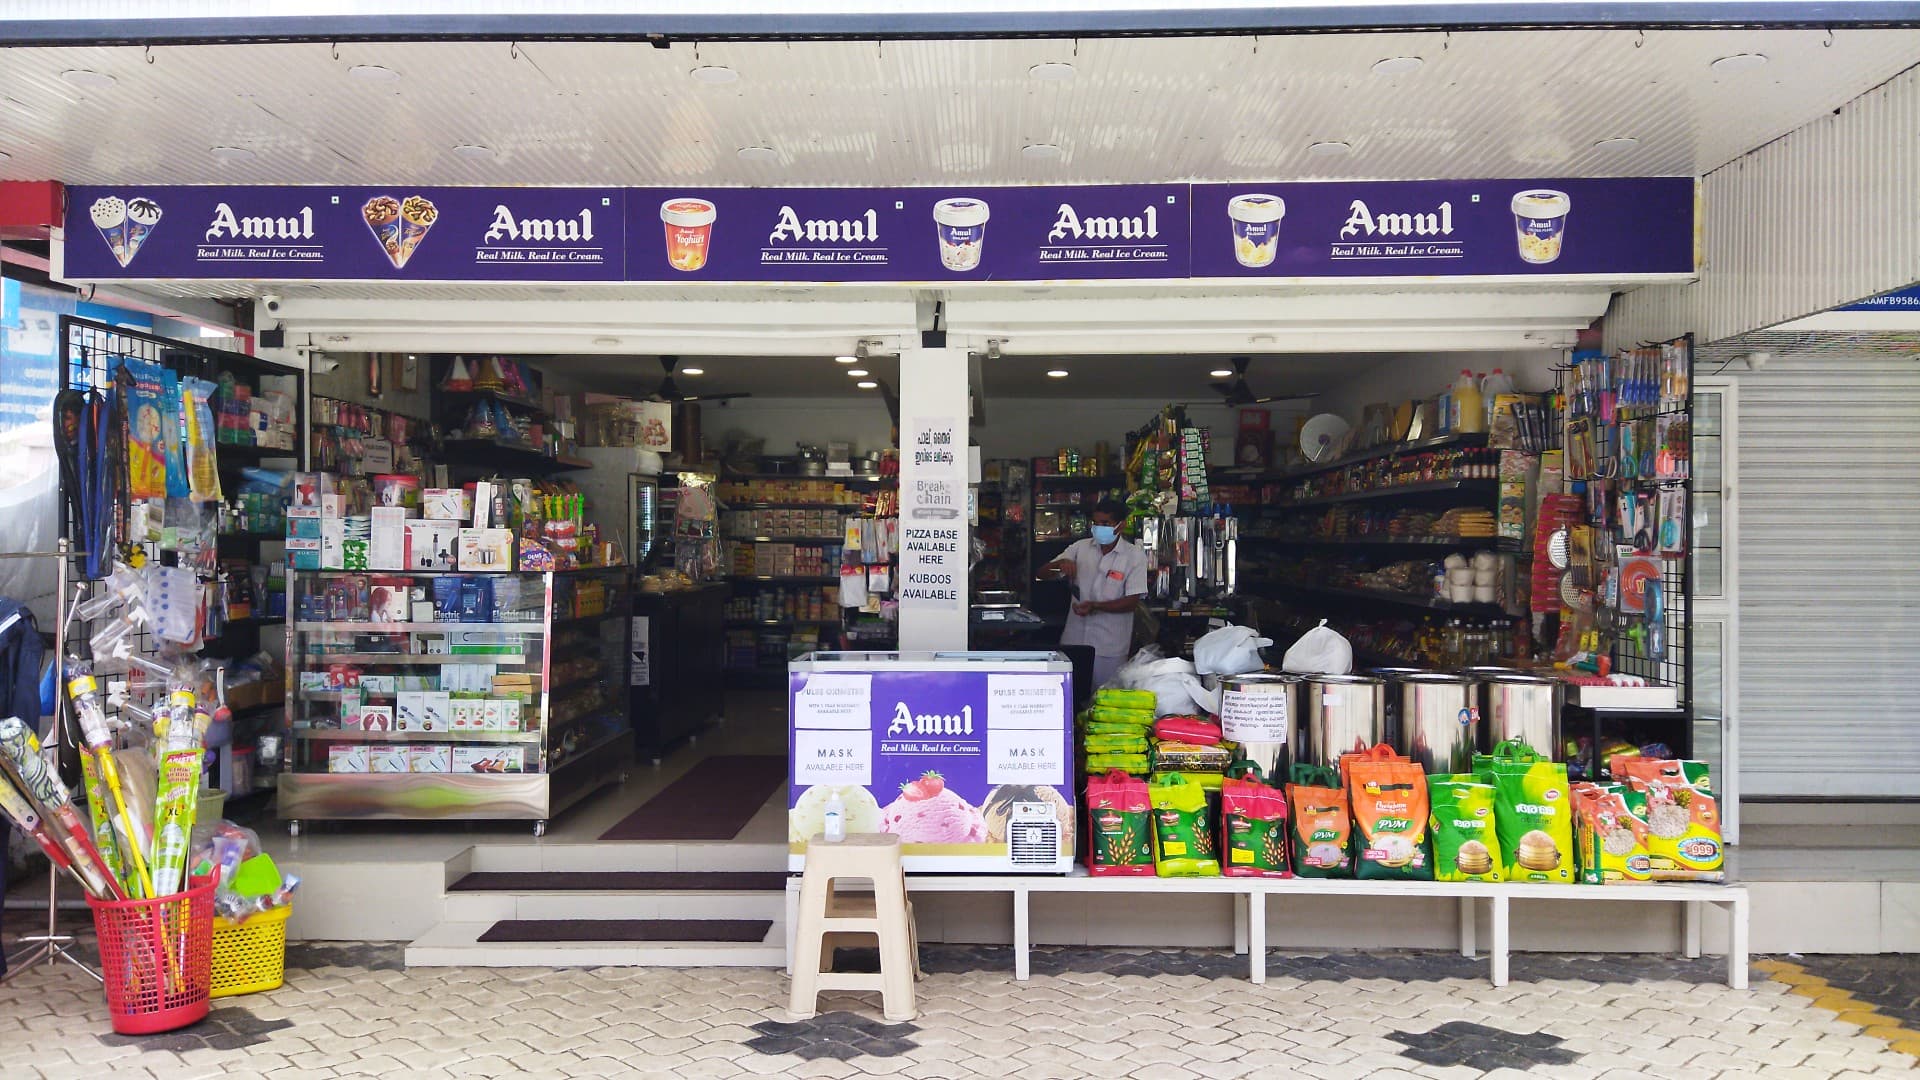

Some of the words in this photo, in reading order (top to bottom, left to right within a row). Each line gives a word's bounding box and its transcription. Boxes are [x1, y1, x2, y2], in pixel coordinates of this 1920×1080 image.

[205, 202, 315, 243] Amul
[484, 204, 594, 245] Amul
[1048, 203, 1159, 244] Amul
[1340, 199, 1454, 240] Amul
[1529, 219, 1551, 228] Amul
[769, 205, 879, 246] Amul
[1245, 223, 1267, 232] Amul
[950, 227, 971, 236] Amul
[197, 249, 219, 258] Real
[221, 249, 245, 258] Milk.
[248, 249, 270, 258] Real
[272, 249, 286, 258] Ice
[289, 249, 324, 258] Cream.
[476, 251, 498, 260] Real
[500, 251, 525, 260] Milk.
[528, 251, 550, 260] Real
[552, 251, 566, 260] Ice
[569, 251, 603, 260] Cream.
[1040, 250, 1062, 259] Real
[1064, 250, 1089, 259] Milk.
[1092, 249, 1114, 259] Real
[1116, 249, 1130, 258] Ice
[1133, 249, 1168, 258] Cream.
[1331, 247, 1354, 256] Real
[1356, 246, 1382, 256] Milk.
[1385, 246, 1408, 255] Real
[1410, 246, 1424, 255] Ice
[1427, 245, 1463, 255] Cream.
[761, 252, 783, 261] Real
[785, 252, 810, 261] Milk.
[813, 252, 834, 261] Real
[836, 252, 850, 261] Ice
[853, 252, 888, 261] Cream.
[917, 490, 951, 504] chain
[906, 529, 931, 538] PIZZA
[933, 530, 958, 539] BASE
[907, 542, 957, 552] AVAILABLE
[919, 555, 944, 564] HERE
[909, 573, 951, 584] KUBOOS
[902, 589, 957, 600] AVAILABLE
[434, 610, 460, 618] Electric
[888, 701, 974, 738] Amul
[817, 748, 853, 757] MASK
[881, 744, 898, 752] Real
[900, 744, 920, 752] Milk.
[922, 744, 939, 752] Real
[940, 744, 952, 752] Ice
[953, 744, 981, 752] Cream.
[1009, 748, 1045, 757] MASK
[805, 763, 843, 771] AVAILABLE
[846, 763, 864, 771] HERE
[998, 762, 1035, 770] AVAILABLE
[1038, 762, 1056, 770] HERE
[1378, 819, 1408, 829] PVM
[1314, 831, 1335, 839] PVM
[1692, 845, 1713, 855] 999
